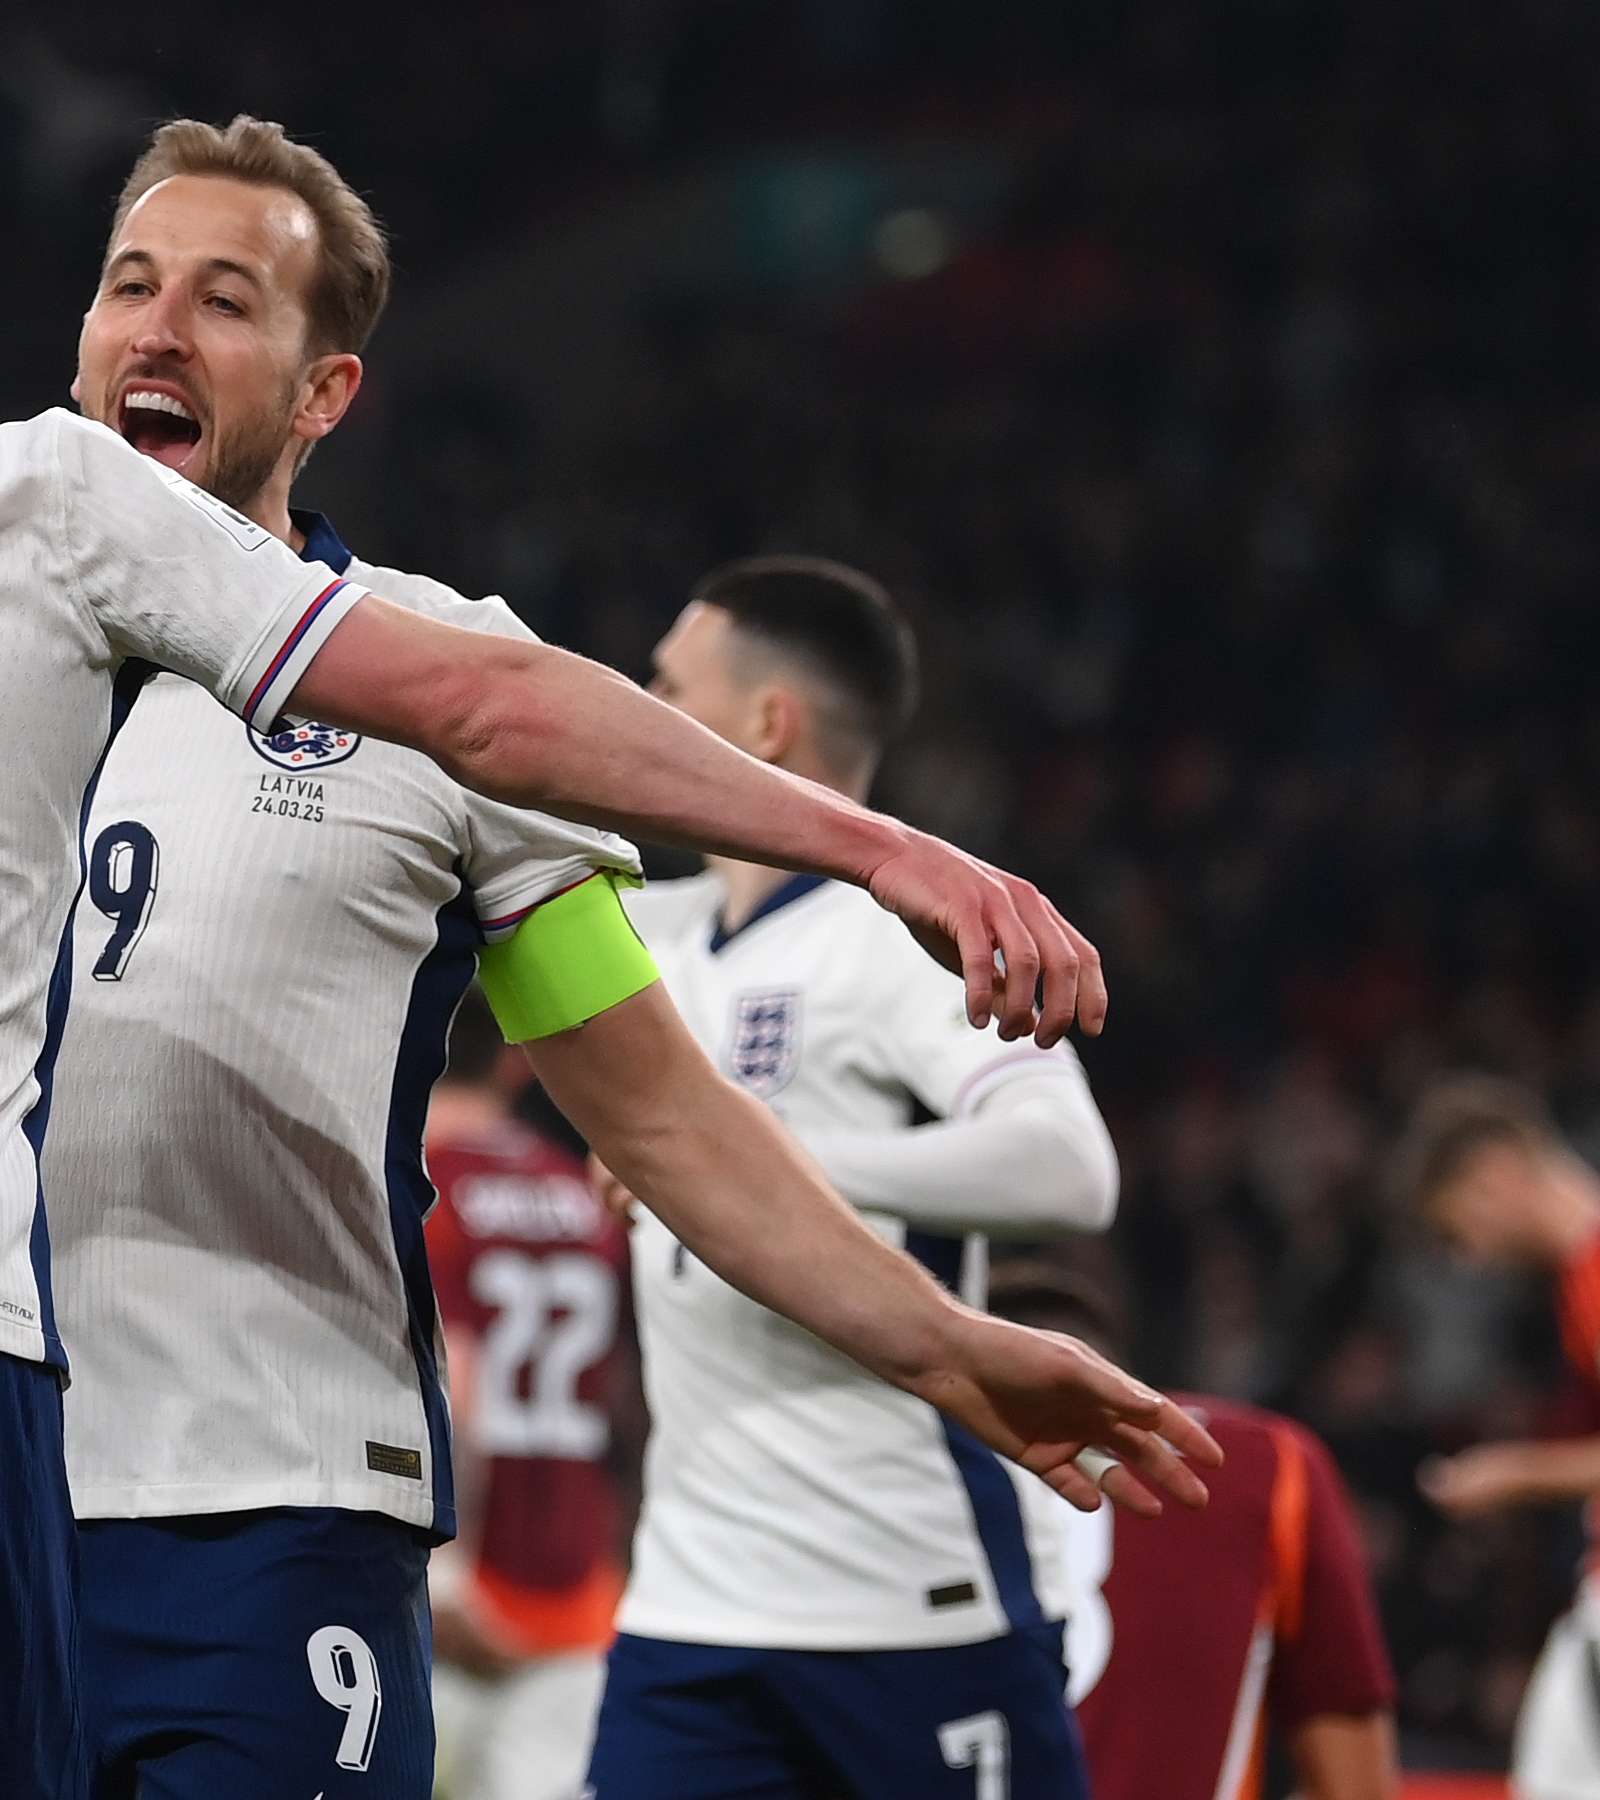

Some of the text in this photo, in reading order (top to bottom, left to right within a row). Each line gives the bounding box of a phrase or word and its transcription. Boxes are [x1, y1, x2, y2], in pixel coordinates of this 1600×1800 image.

[251, 796, 325, 822] 24.03.25
[260, 774, 323, 801] LATVIA
[89, 820, 160, 982] 9
[468, 1248, 620, 1458] 22
[306, 1625, 382, 1772] 9
[937, 1709, 1011, 1800] 7
